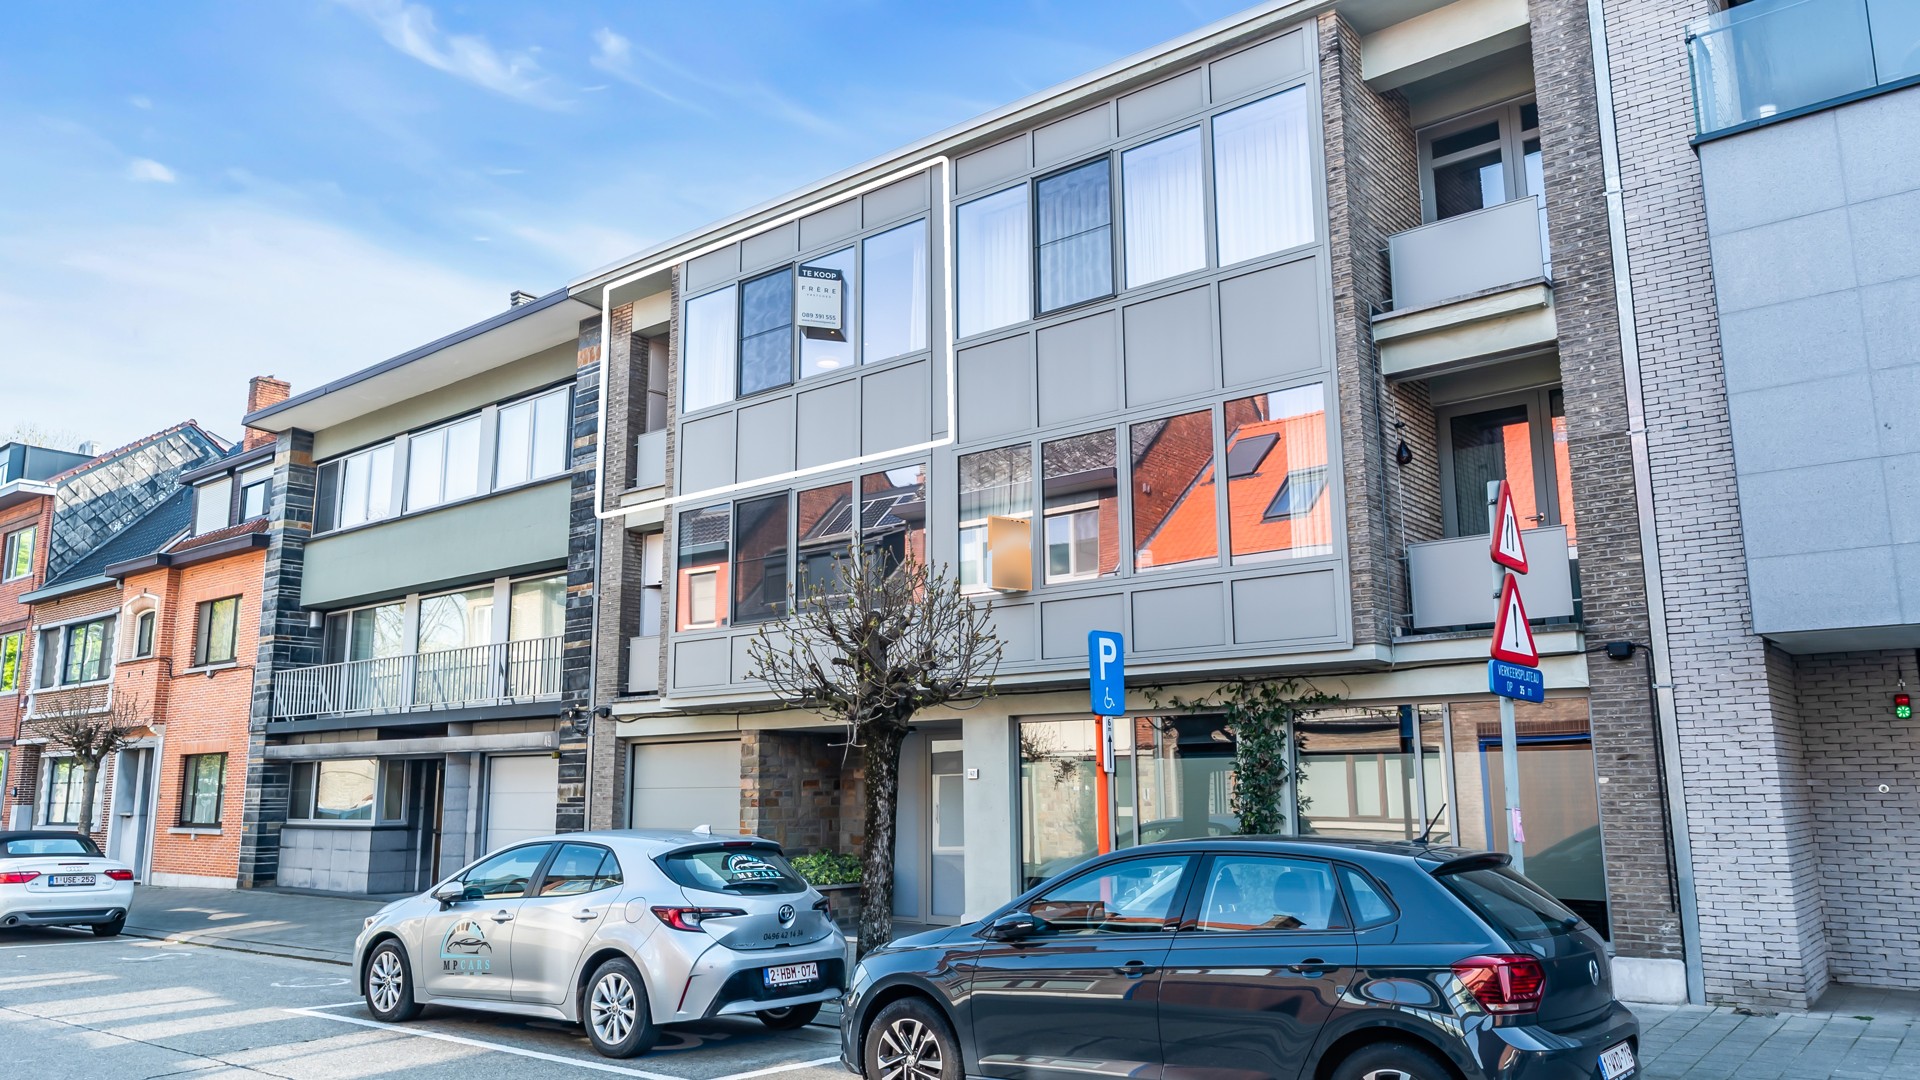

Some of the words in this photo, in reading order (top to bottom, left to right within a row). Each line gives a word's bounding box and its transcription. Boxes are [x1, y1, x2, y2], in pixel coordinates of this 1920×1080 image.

[814, 271, 837, 279] KOOP
[1099, 637, 1117, 680] P
[1498, 664, 1540, 684] VERKEERSPLATEAU
[1506, 681, 1513, 692] OP
[1107, 718, 1112, 726] 6
[55, 876, 95, 884] 1-USE-252
[763, 932, 779, 941] 0496
[781, 931, 788, 939] 42
[790, 930, 796, 938] 14
[770, 964, 817, 982] 2-HBM-074
